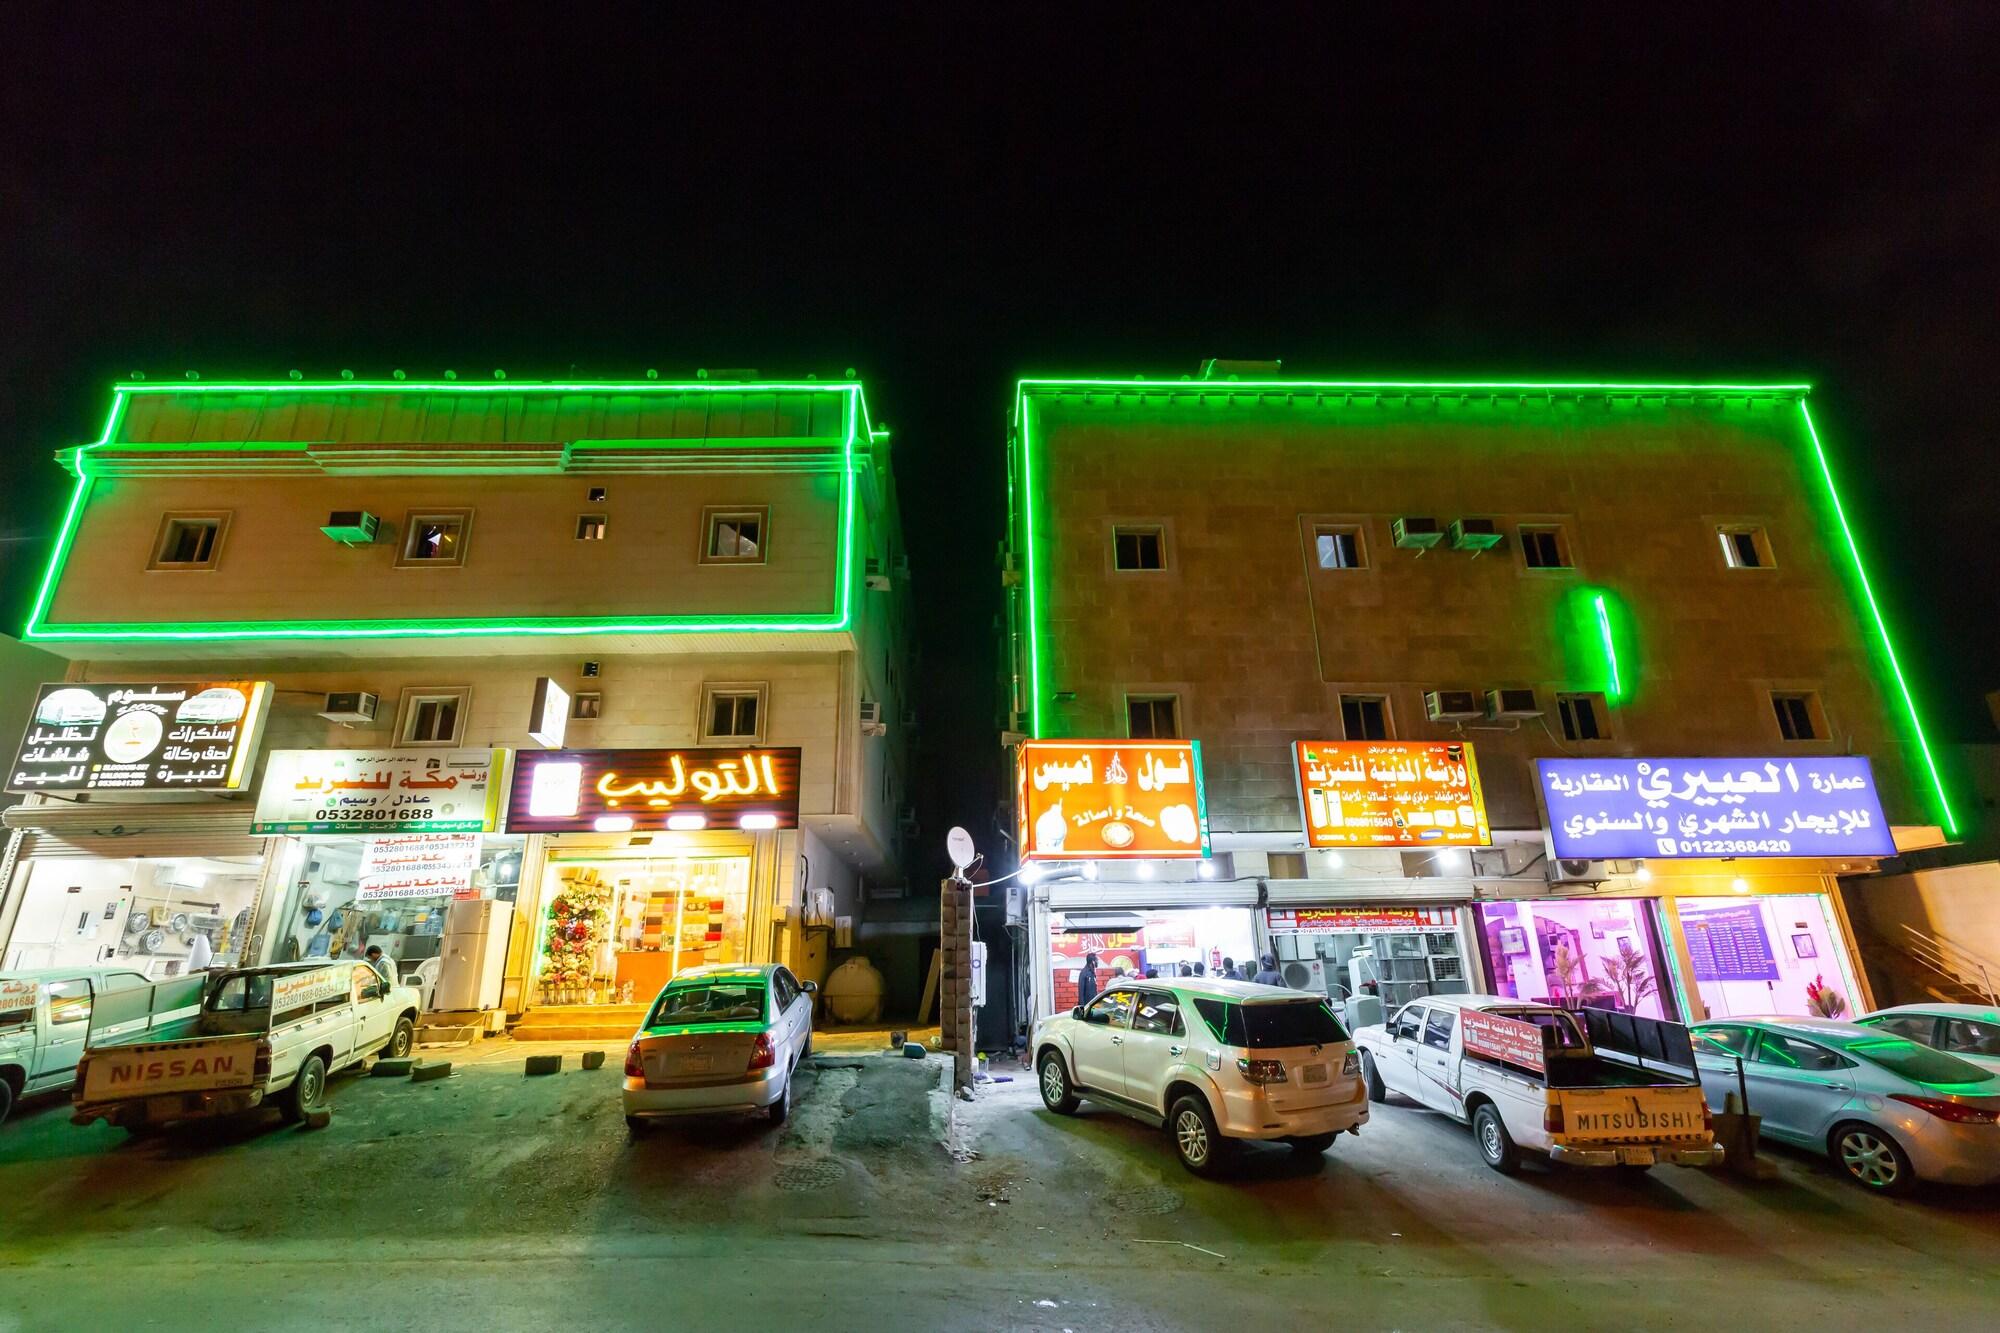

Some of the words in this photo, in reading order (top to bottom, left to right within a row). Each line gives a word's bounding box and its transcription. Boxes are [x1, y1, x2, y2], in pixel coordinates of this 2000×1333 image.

[294, 771, 392, 795] للتبريد
[398, 769, 459, 790] مكة
[459, 768, 488, 782] ورشة
[597, 754, 780, 807] التوليب
[1137, 752, 1190, 792] فول
[1309, 755, 1367, 788] للتبريد
[1370, 757, 1421, 787] المدينة
[1425, 758, 1467, 787] ورشة
[1546, 771, 1630, 797] العقارية
[1808, 771, 1866, 794] عمارة
[339, 794, 376, 808] وسيم
[392, 794, 430, 806] عادل
[315, 808, 434, 821] 0532801688
[1563, 810, 1669, 839] والسنوي
[1678, 808, 1771, 838] الشهري
[1778, 810, 1872, 836] للإيجار
[1680, 840, 1792, 853] 0122368420
[110, 1056, 234, 1084] NISSAN
[1577, 1112, 1693, 1131] MITSUBISHI
